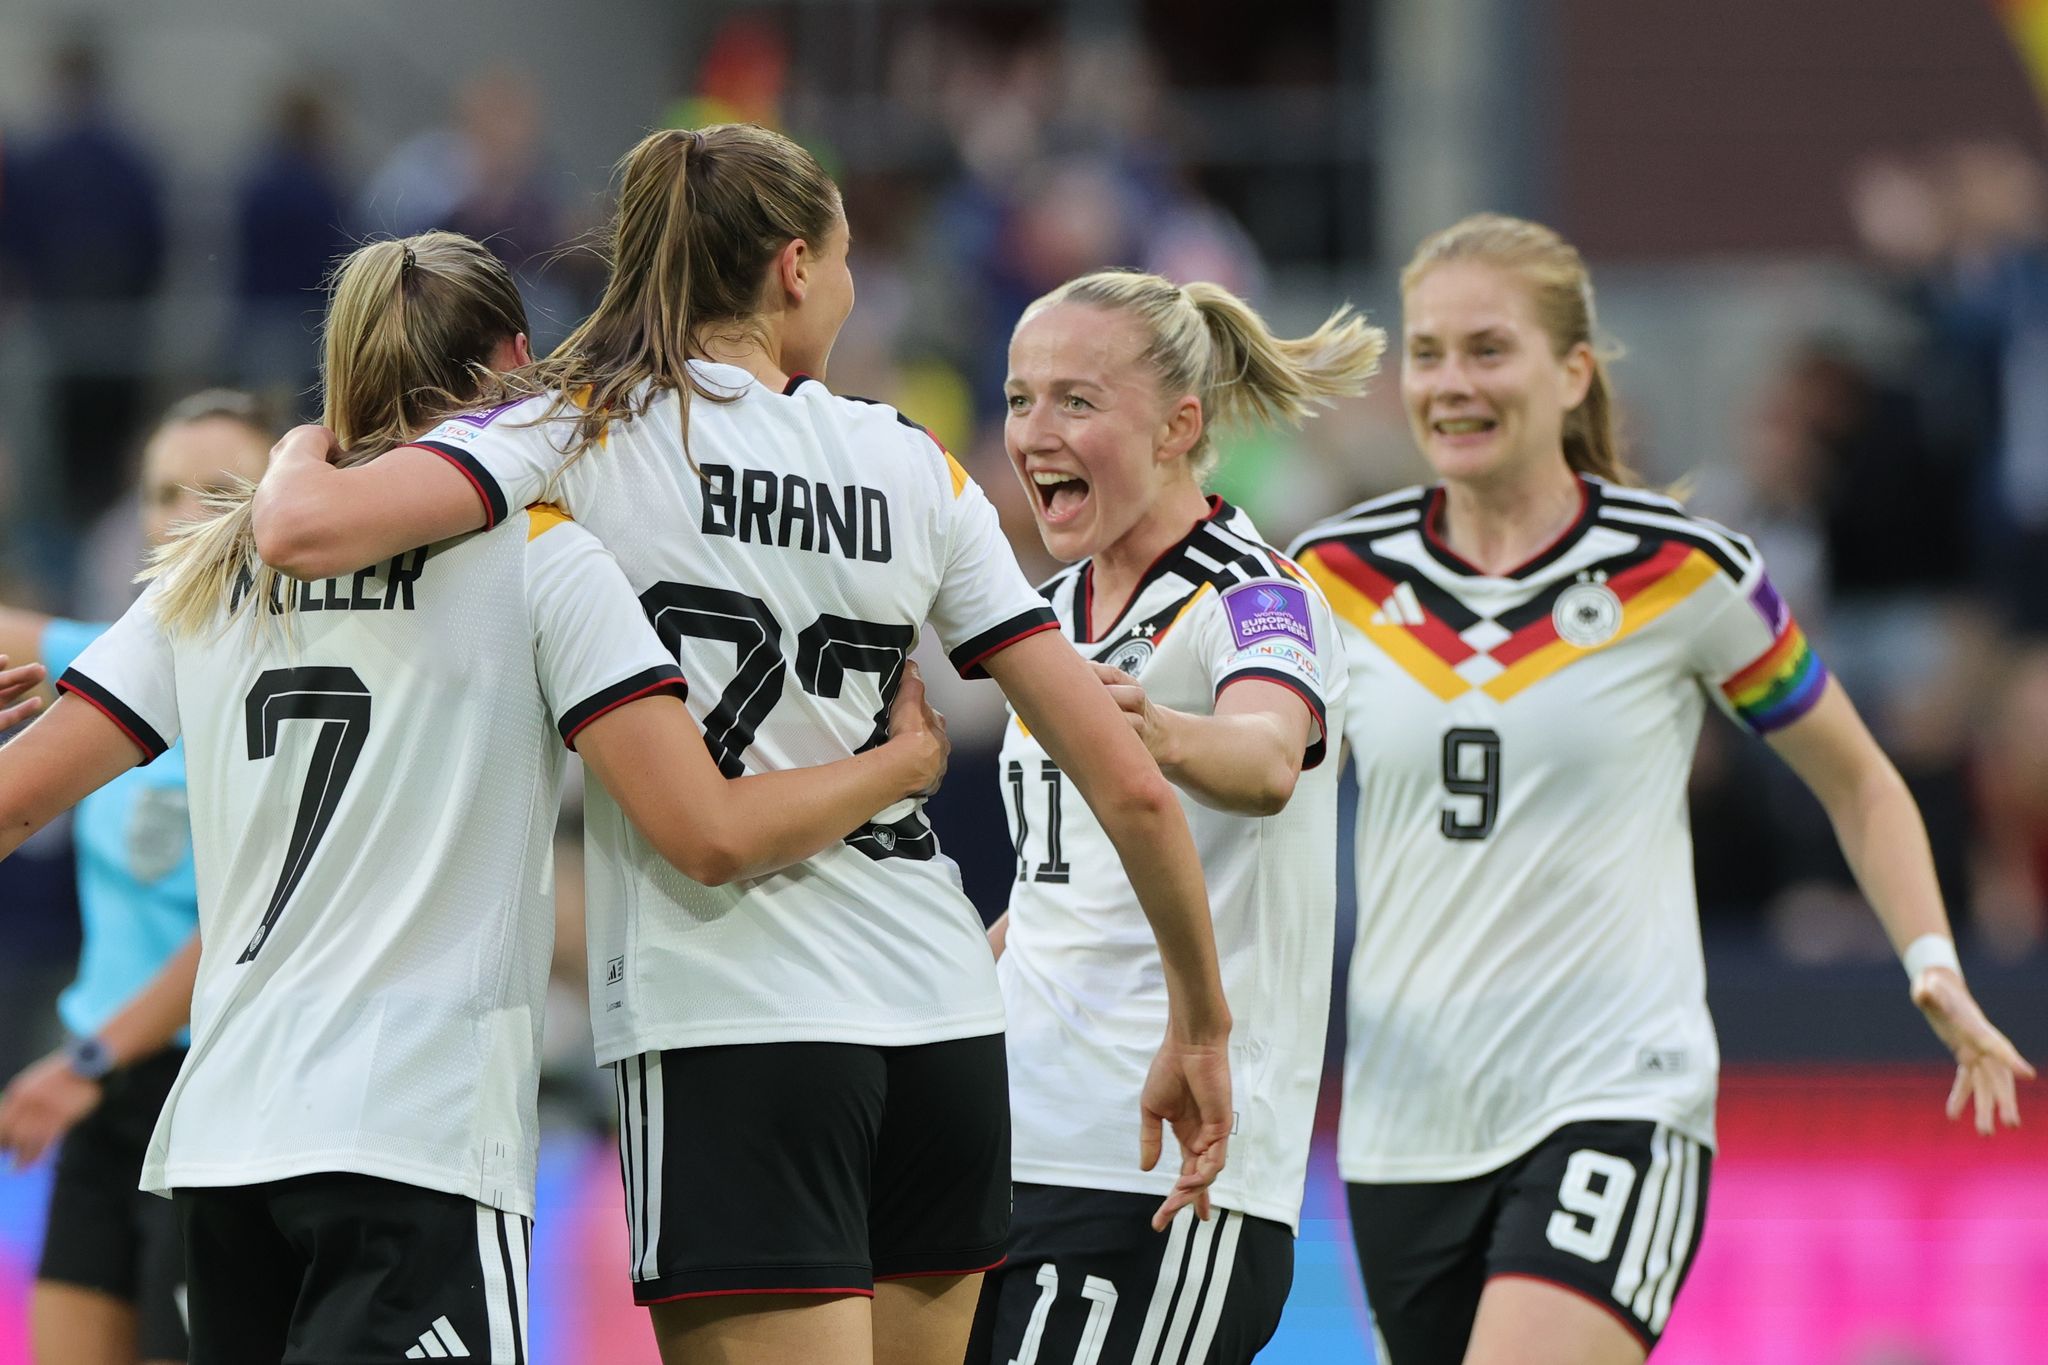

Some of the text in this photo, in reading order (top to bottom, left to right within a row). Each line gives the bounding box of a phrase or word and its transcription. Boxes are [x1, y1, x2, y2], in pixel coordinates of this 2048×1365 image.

[699, 463, 893, 563] BRAND
[1227, 645, 1321, 680] FOUNDATION
[1241, 616, 1307, 633] EUROPEAN
[1242, 623, 1309, 641] QUALIFIERS
[234, 665, 372, 965] 7
[1007, 759, 1071, 884] 11
[1440, 727, 1501, 841] 9
[1545, 1147, 1637, 1263] 9
[1007, 1262, 1119, 1365] 11
